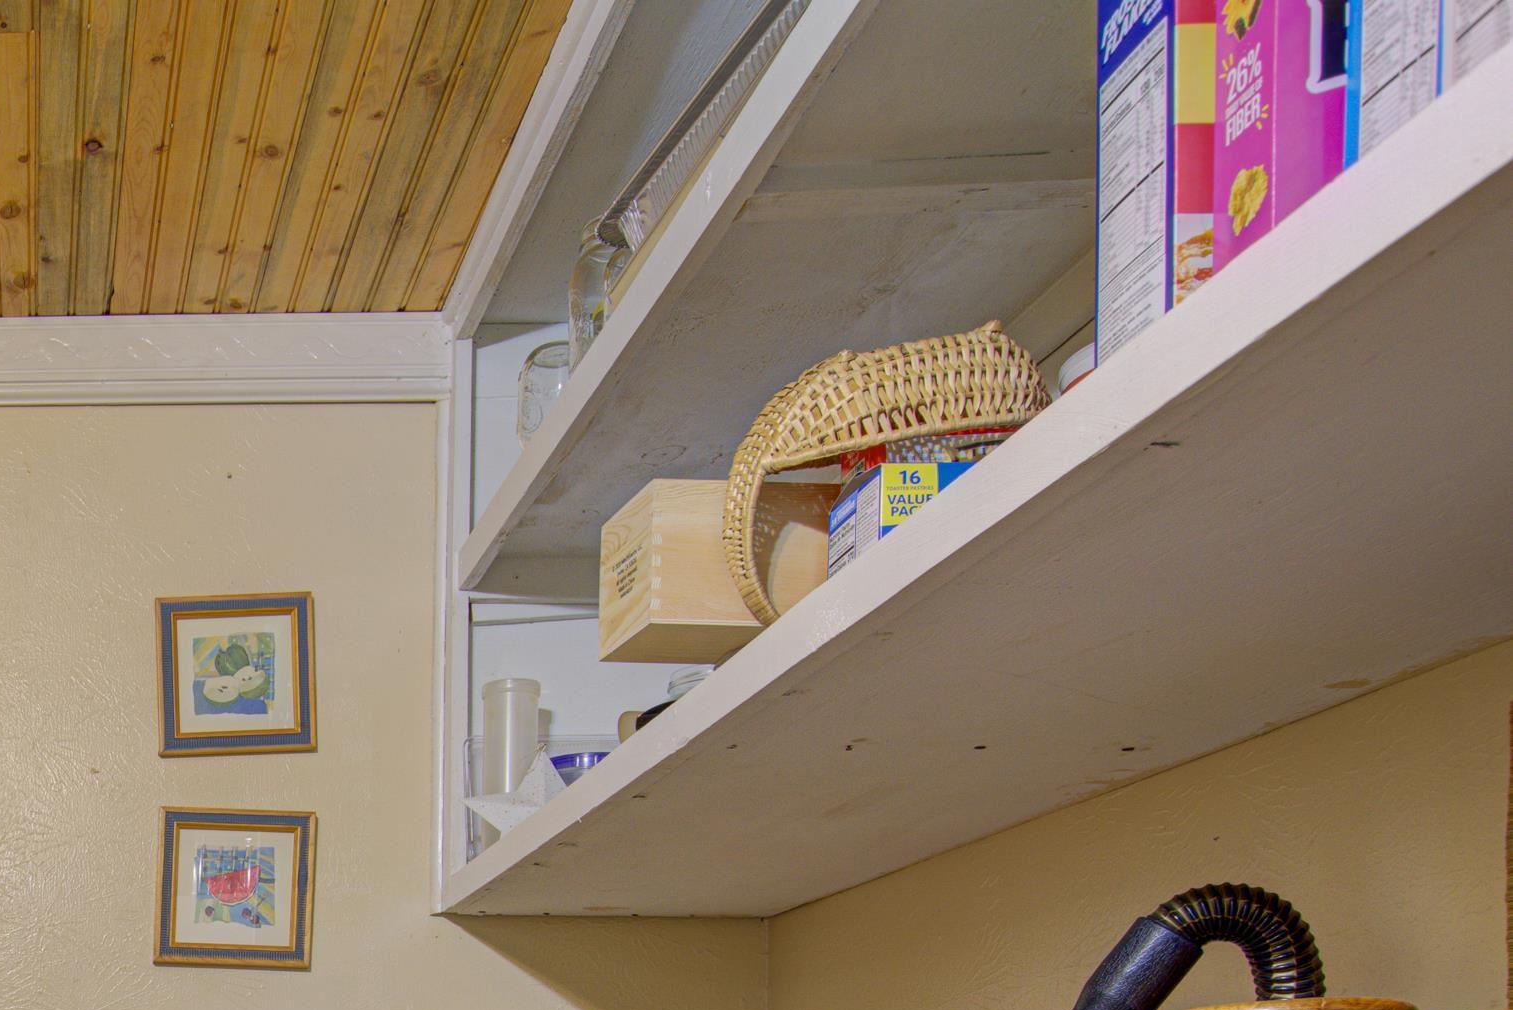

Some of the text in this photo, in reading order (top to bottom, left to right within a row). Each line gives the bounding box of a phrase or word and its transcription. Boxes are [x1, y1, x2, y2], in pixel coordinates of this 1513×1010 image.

[1225, 42, 1262, 104] 26%
[1224, 93, 1261, 147] FIBER
[899, 470, 922, 485] 16
[891, 506, 922, 517] PAC
